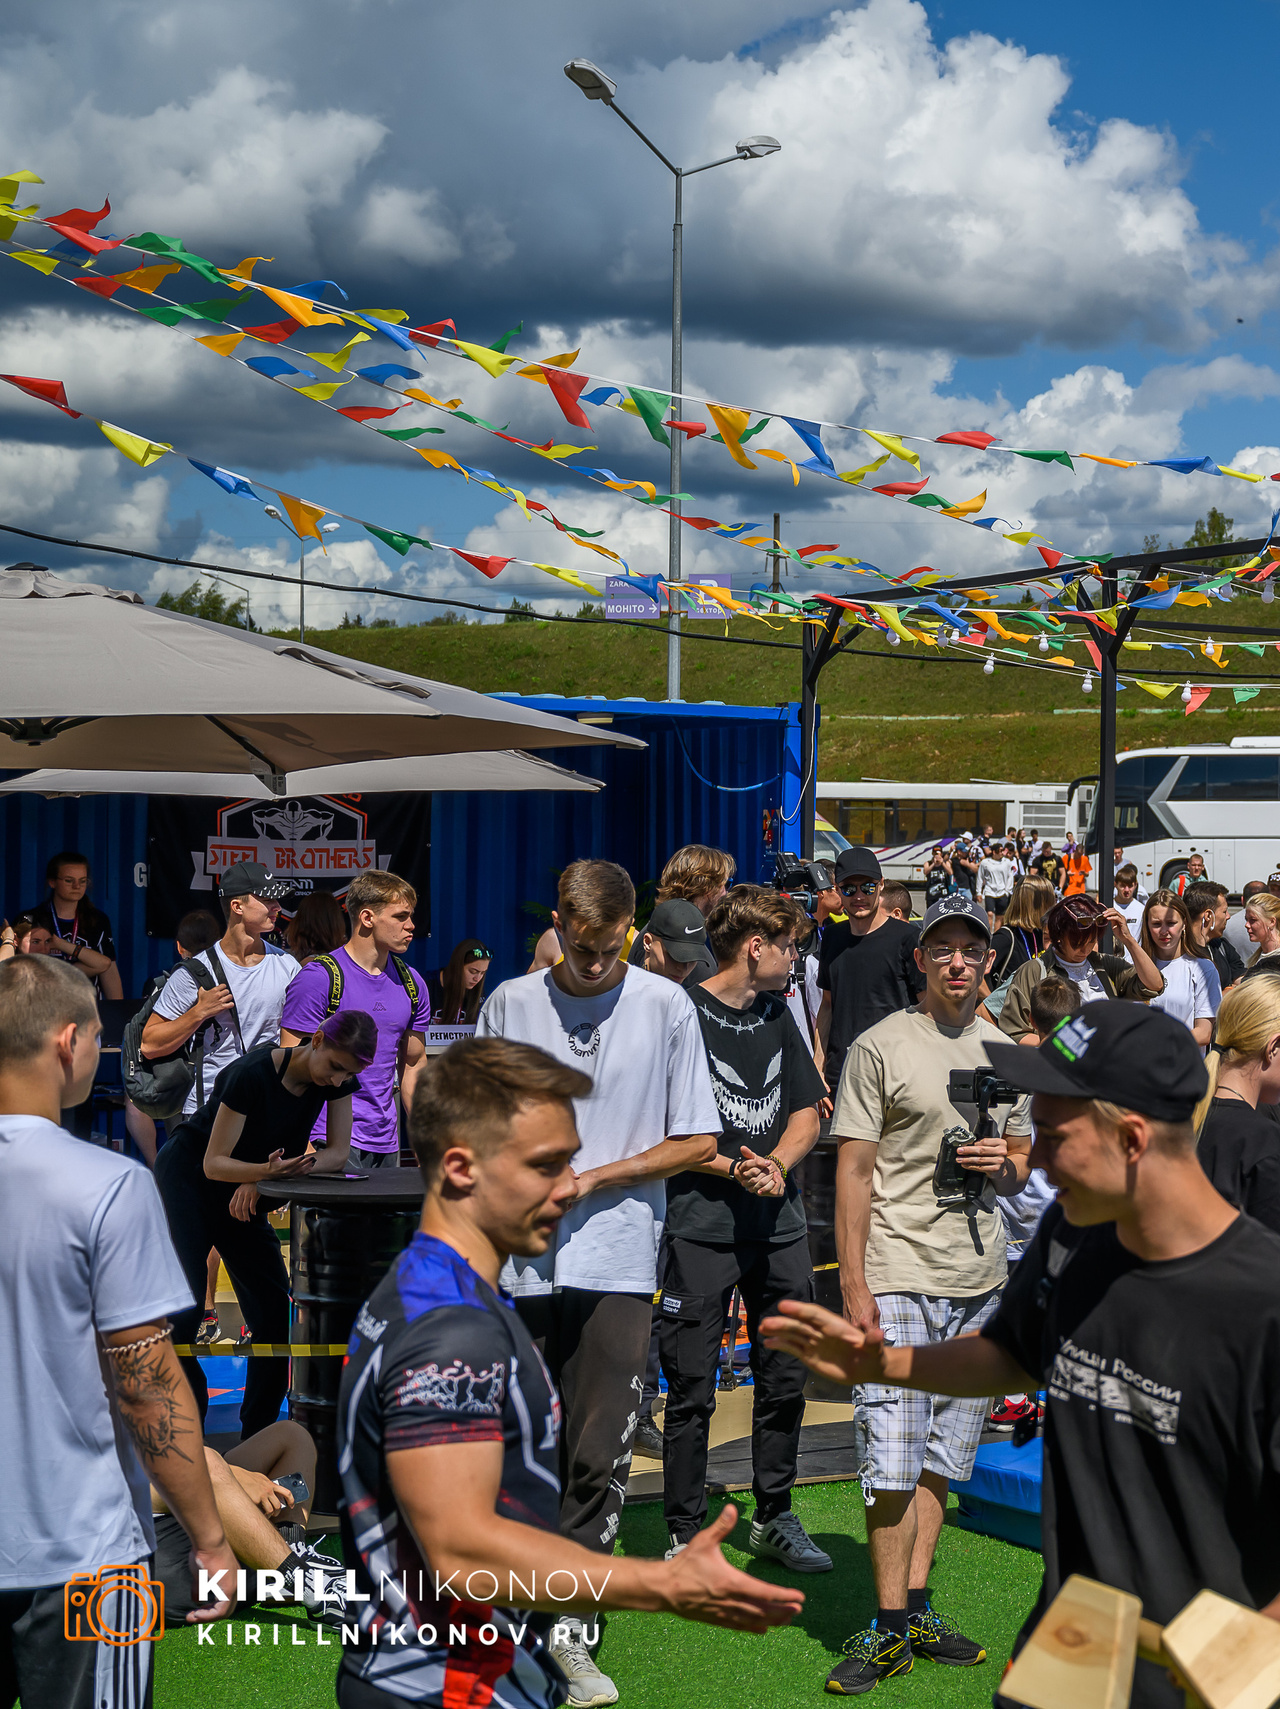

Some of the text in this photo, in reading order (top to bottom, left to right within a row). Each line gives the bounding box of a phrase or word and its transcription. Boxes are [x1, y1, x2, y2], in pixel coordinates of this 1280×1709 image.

[607, 604, 645, 613] MOHITO
[696, 607, 722, 615] ектор
[273, 846, 375, 869] BROTHERS
[1112, 1357, 1183, 1404] России
